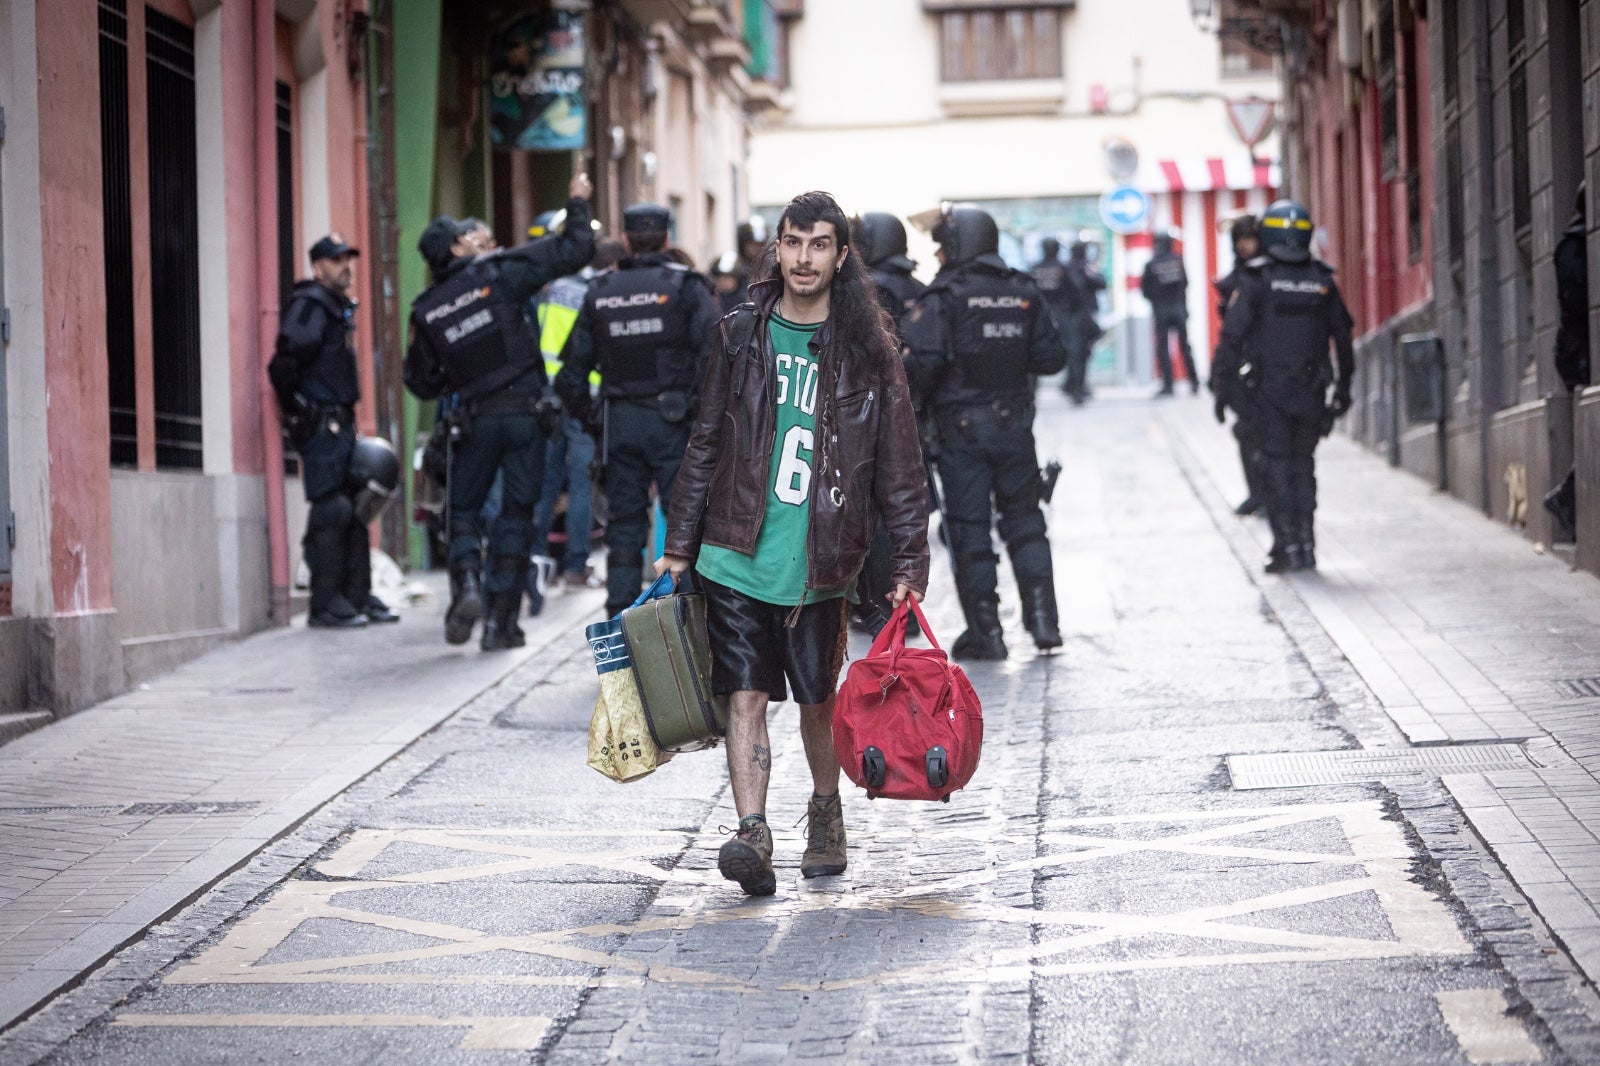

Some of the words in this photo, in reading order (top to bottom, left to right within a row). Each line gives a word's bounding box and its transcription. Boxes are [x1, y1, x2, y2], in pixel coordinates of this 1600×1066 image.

[1270, 280, 1321, 292] POLICIA
[425, 288, 482, 324] POLICIA
[595, 293, 658, 310] POLICIA
[967, 296, 1021, 308] POLICIA
